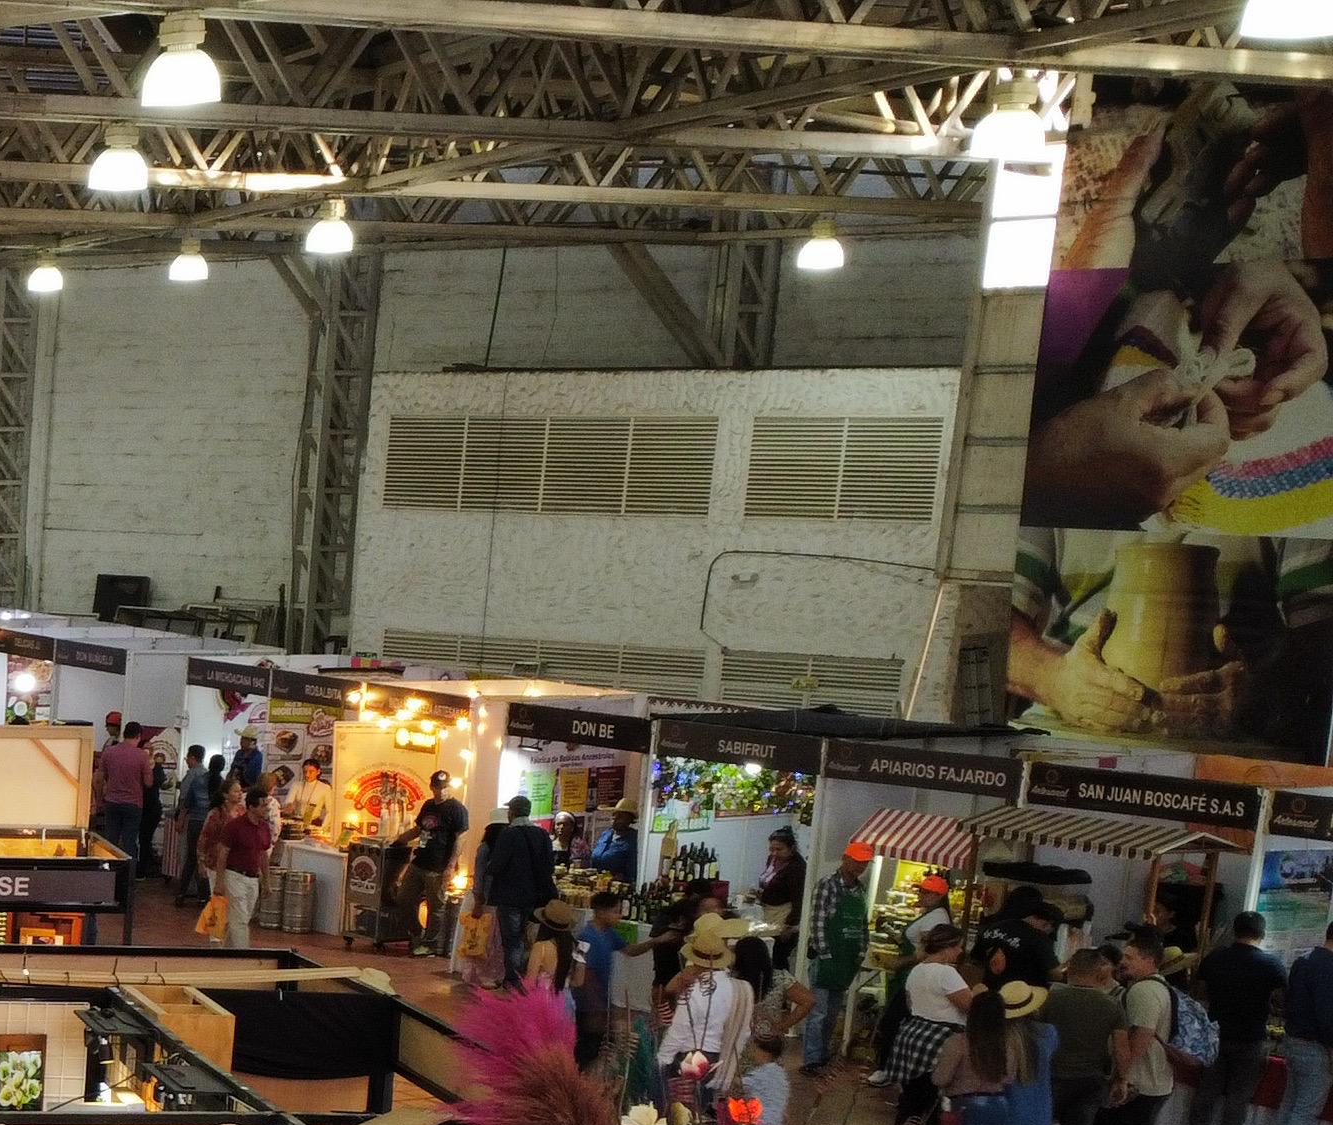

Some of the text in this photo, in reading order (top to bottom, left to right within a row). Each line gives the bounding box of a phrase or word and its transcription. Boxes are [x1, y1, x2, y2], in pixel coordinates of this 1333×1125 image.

[304, 684, 342, 701] ROSALBITA
[572, 719, 615, 739] DON BE
[718, 739, 776, 759] SABIFRUT
[870, 758, 1007, 788] APIARIOS FAJARDO
[1078, 782, 1245, 817] SAN JUAN BOSCAFÉ S.A.S
